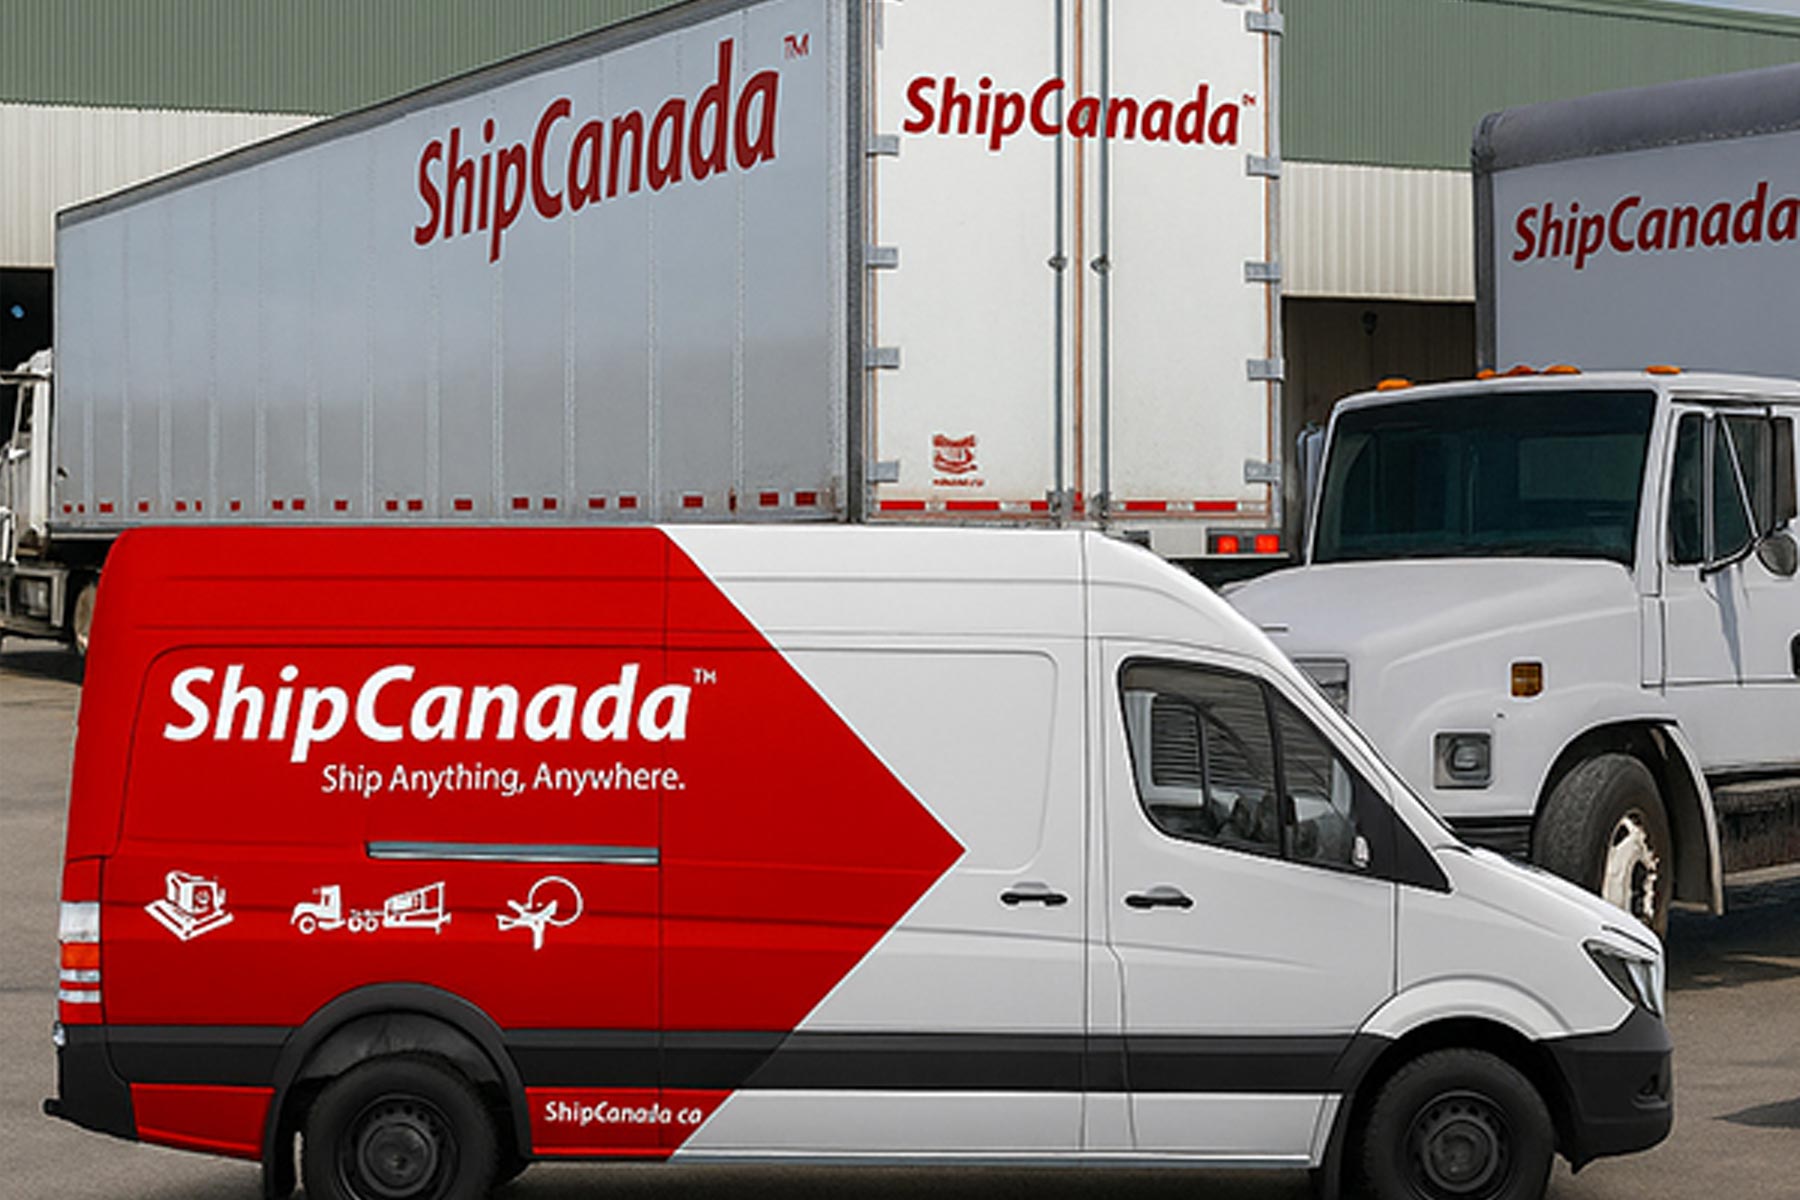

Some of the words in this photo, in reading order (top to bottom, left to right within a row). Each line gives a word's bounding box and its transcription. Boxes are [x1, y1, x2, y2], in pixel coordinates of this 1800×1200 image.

[414, 38, 779, 263] ShipCanada
[903, 76, 1240, 151] ShipCanada
[1513, 181, 1800, 270] ShipCanada
[163, 663, 691, 763] ShipCanada
[321, 765, 383, 797] Ship
[388, 764, 526, 798] Anything,
[532, 763, 687, 797] Anywhere.
